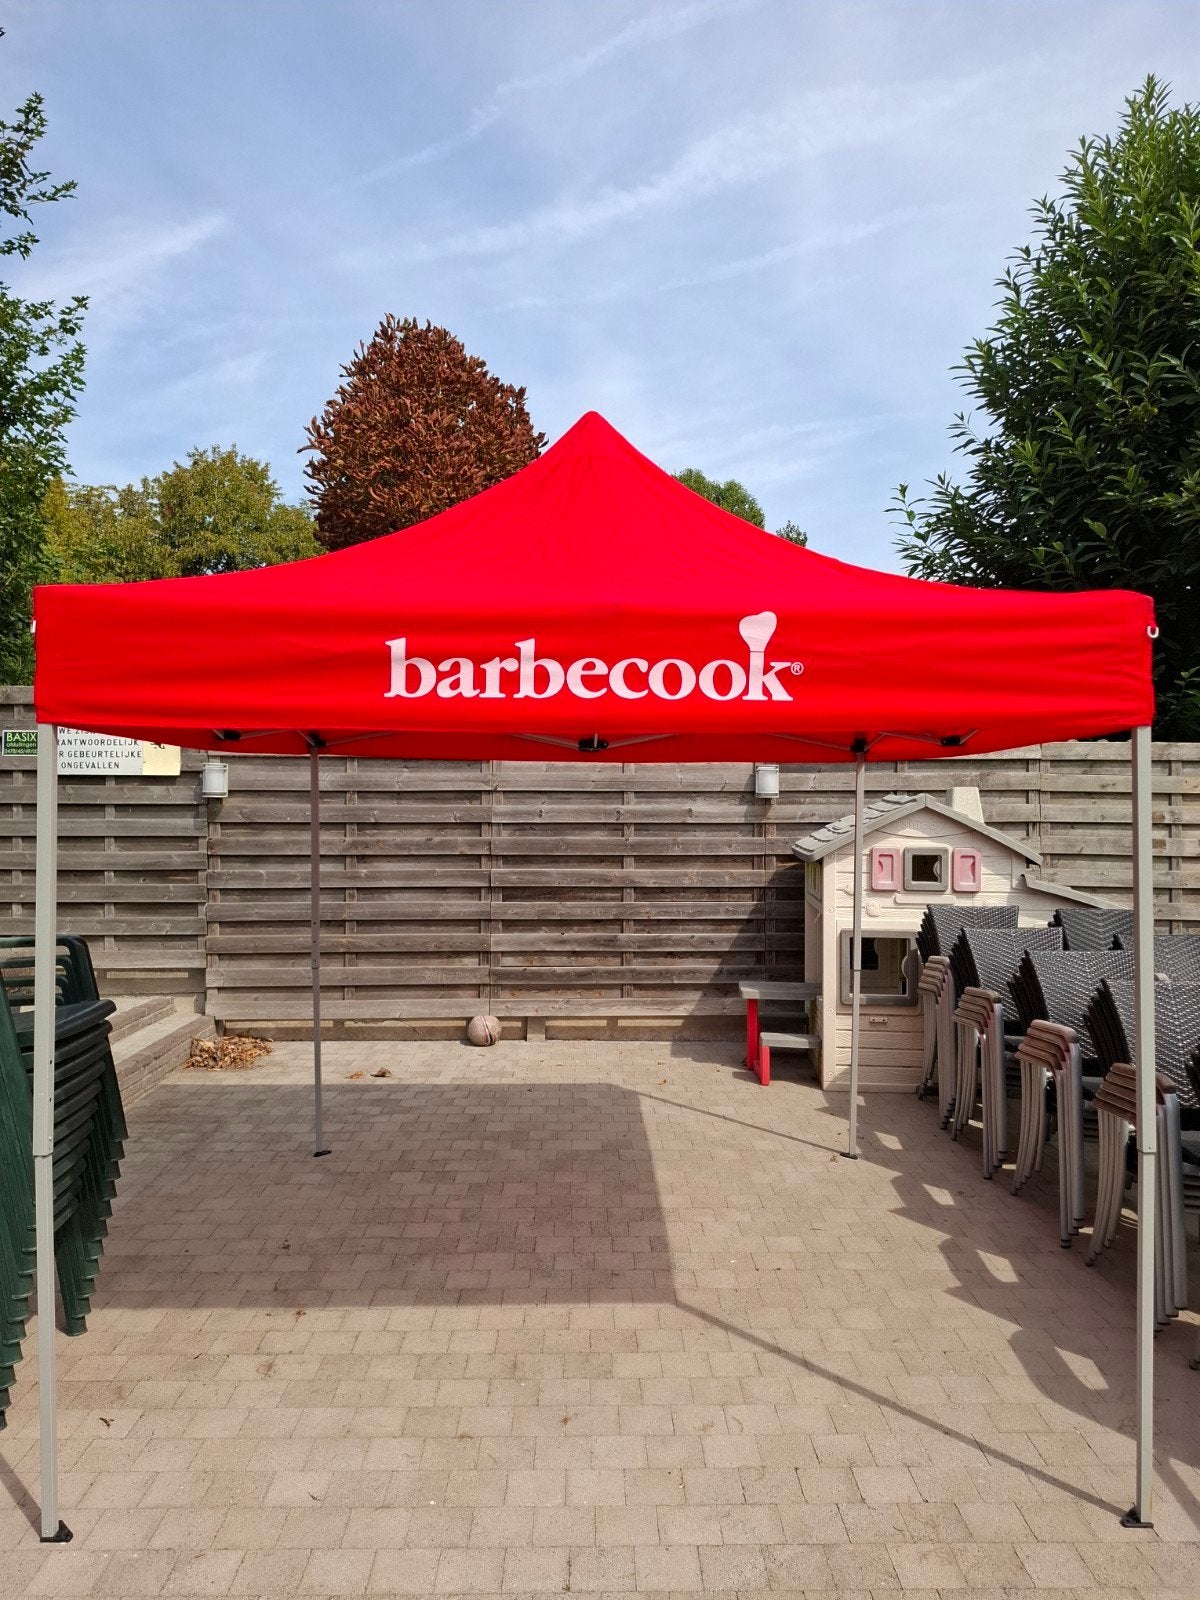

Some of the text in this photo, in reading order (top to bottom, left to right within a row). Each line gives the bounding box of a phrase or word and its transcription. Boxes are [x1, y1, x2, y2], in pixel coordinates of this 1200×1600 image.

[58, 727, 72, 735] WE
[6, 732, 37, 742] BASIX
[67, 750, 142, 758] GEBEURTELIJKE
[61, 761, 120, 769] ONGEVALLEN
